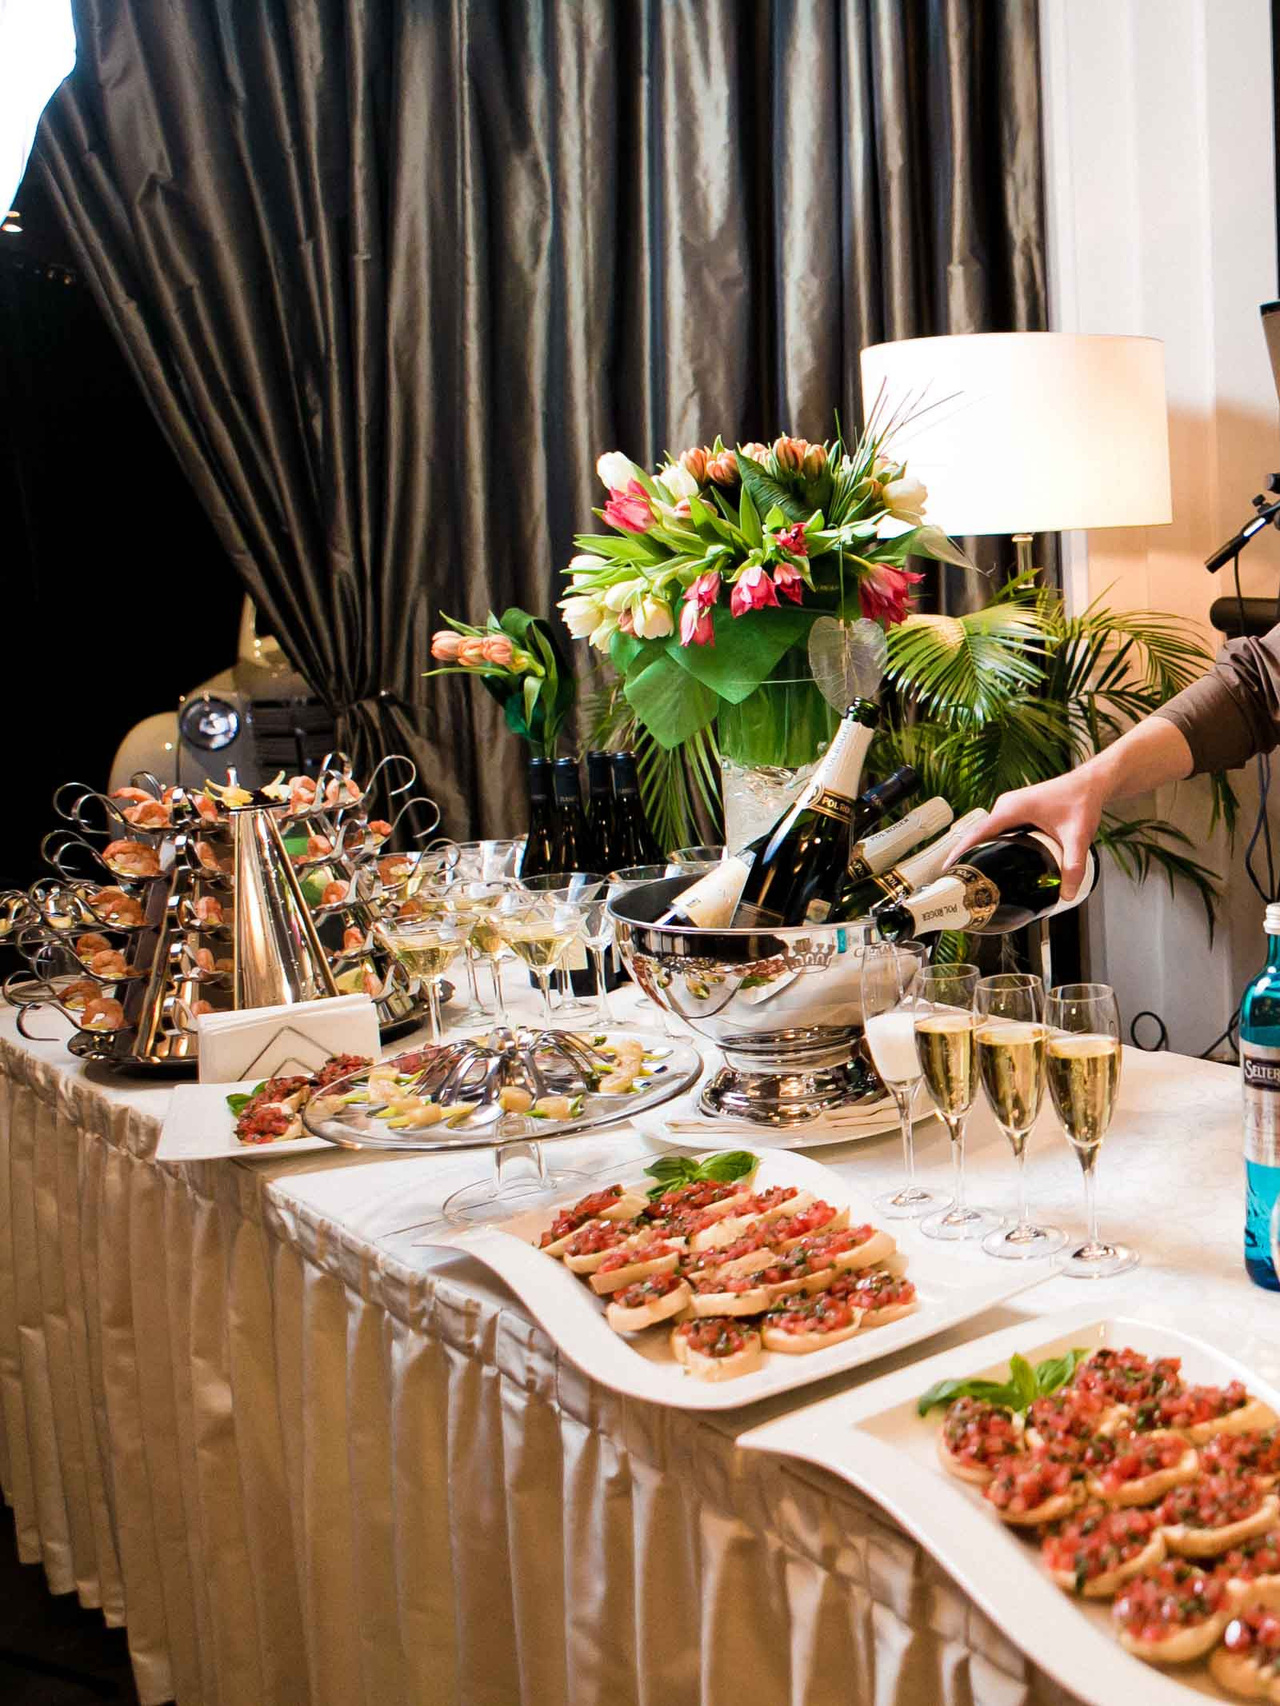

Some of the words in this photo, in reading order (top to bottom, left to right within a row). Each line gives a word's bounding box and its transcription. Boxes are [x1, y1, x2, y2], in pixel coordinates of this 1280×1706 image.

[822, 796, 839, 809] POL
[870, 831, 885, 842] POL
[885, 817, 910, 834] ROGER
[921, 907, 944, 921] ROGER
[944, 904, 958, 914] POL
